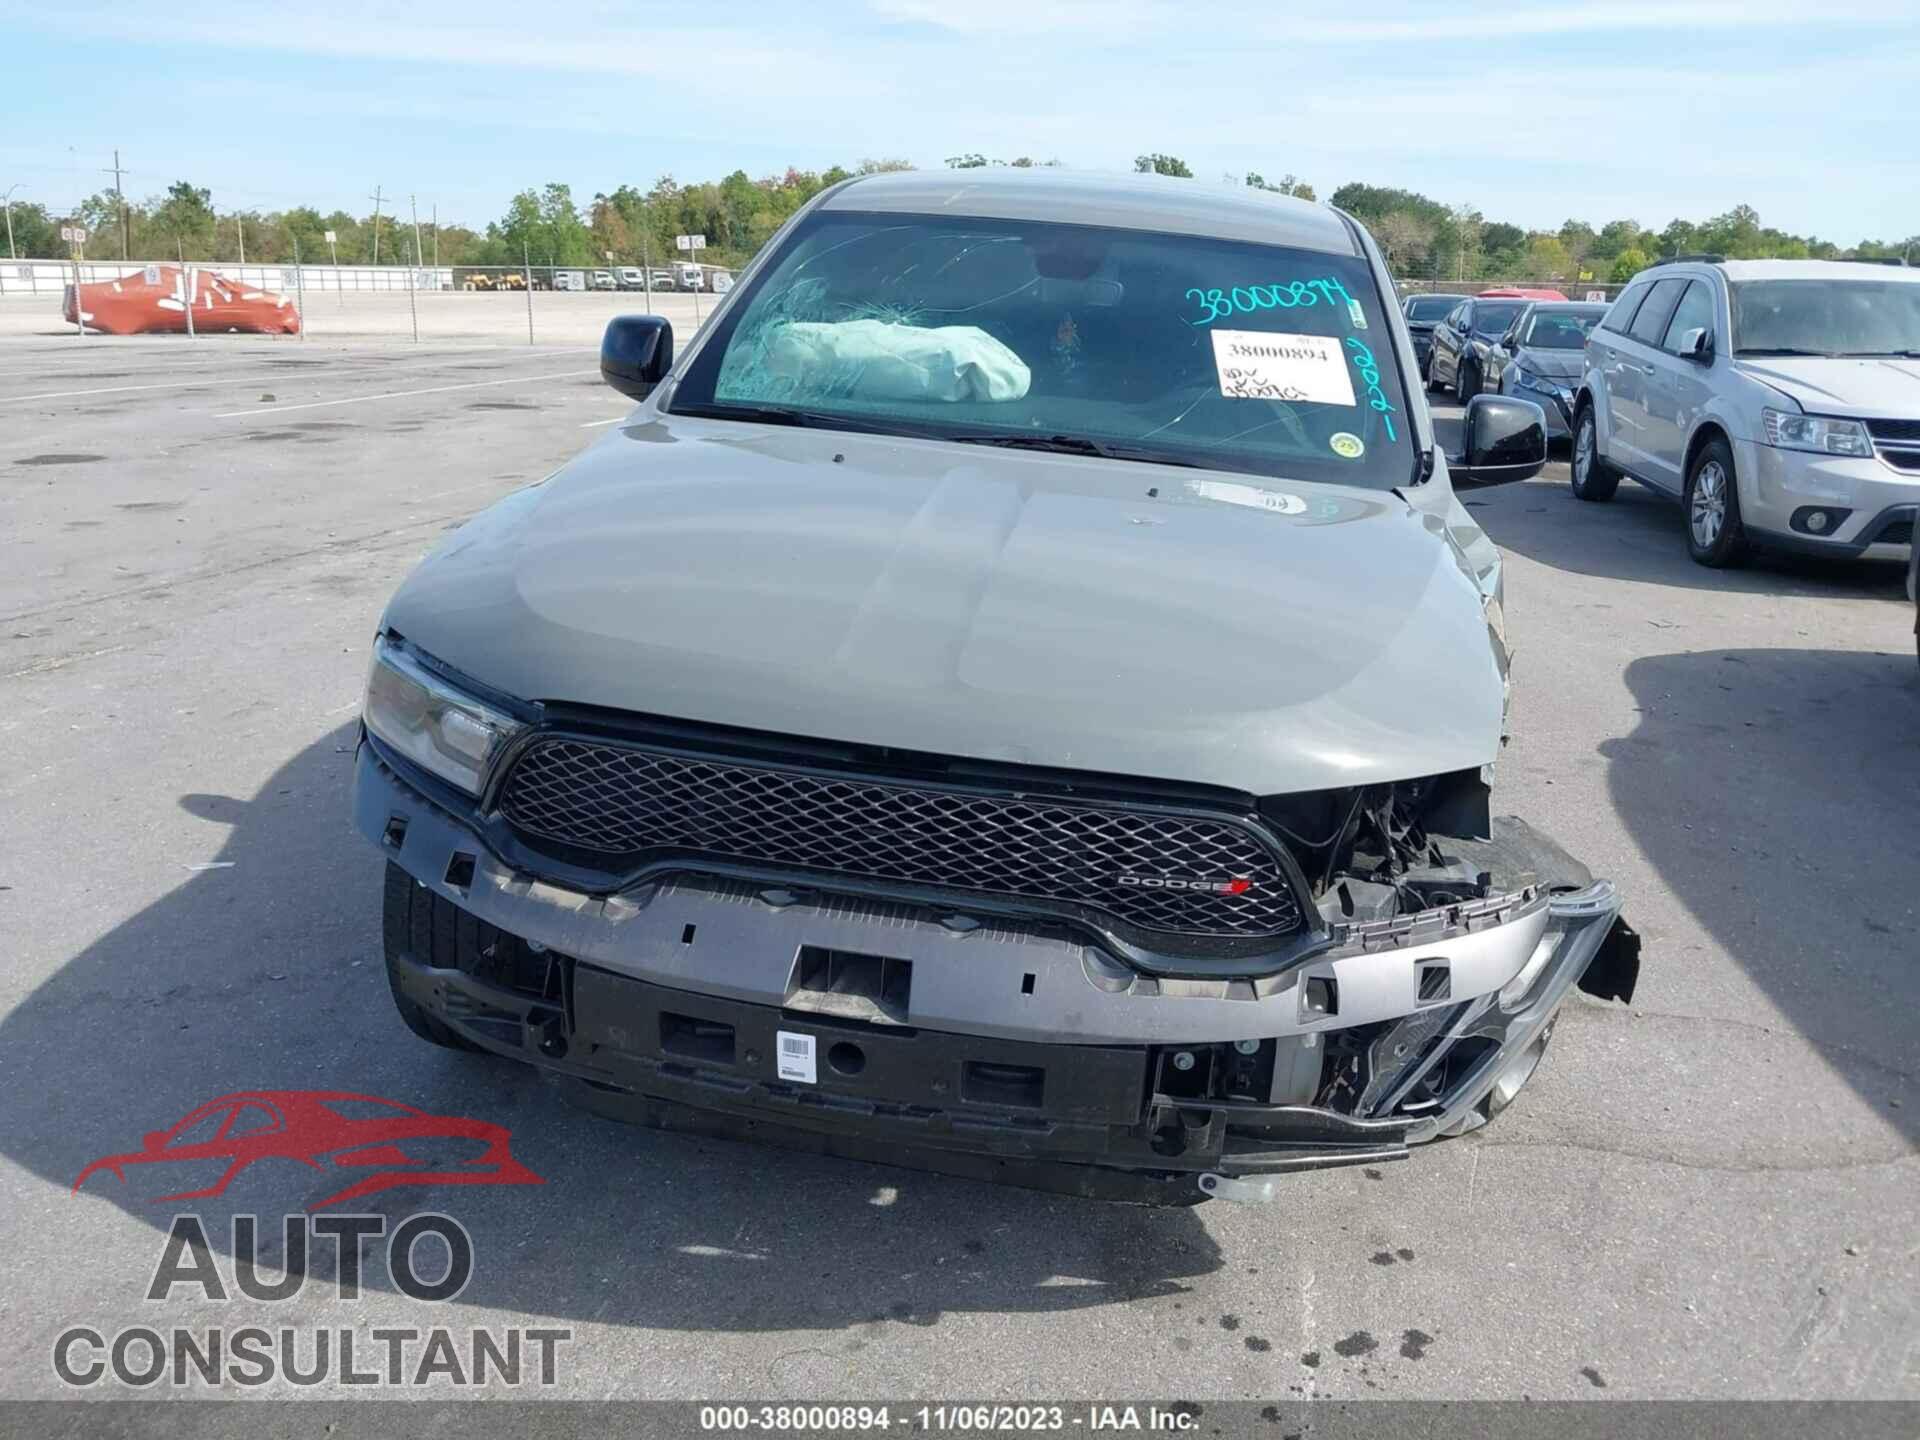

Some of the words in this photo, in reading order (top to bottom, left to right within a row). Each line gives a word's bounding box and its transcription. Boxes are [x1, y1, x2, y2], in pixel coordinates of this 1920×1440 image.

[1186, 277, 1351, 325] 38000894
[1227, 344, 1328, 361] 38000894
[1117, 875, 1232, 892] DODGE
